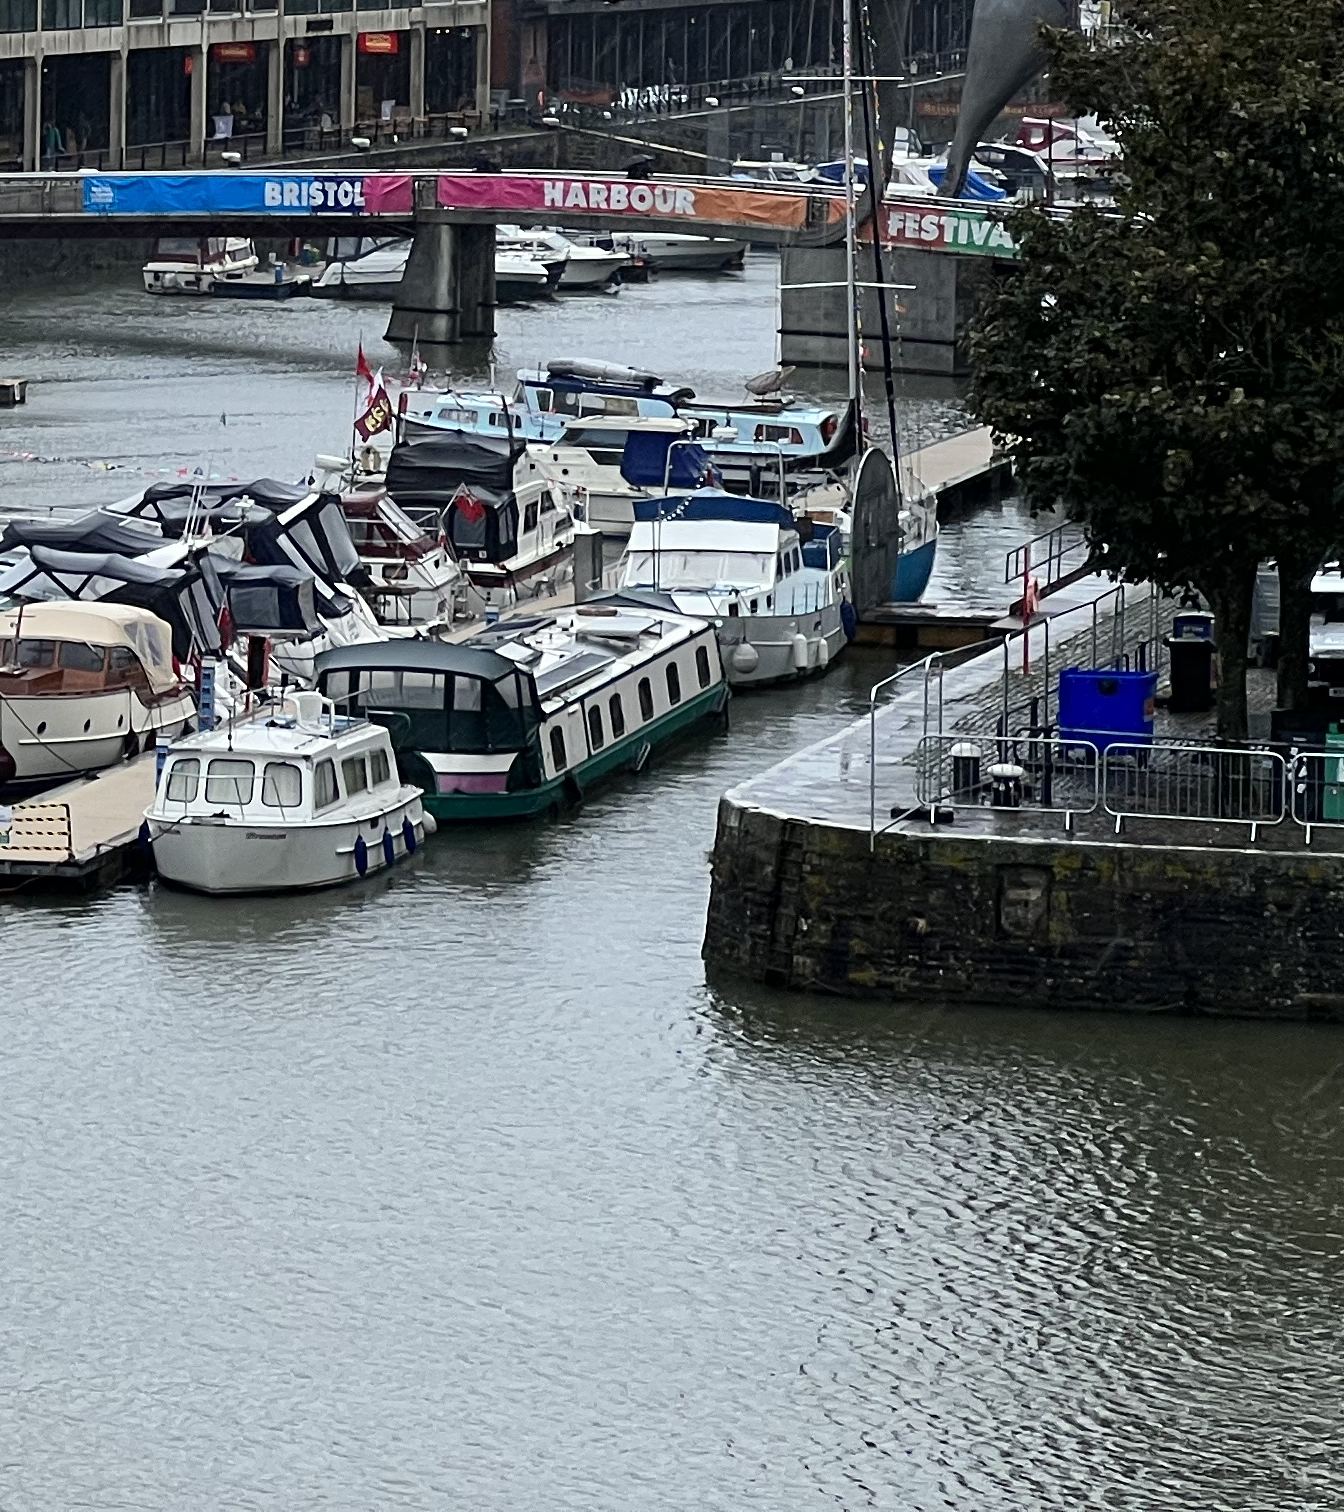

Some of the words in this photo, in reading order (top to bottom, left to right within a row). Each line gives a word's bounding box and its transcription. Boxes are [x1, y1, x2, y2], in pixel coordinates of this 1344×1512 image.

[264, 181, 366, 207] BRISTOL
[543, 181, 697, 216] HARBOUR
[887, 211, 1018, 250] FESTIVA
